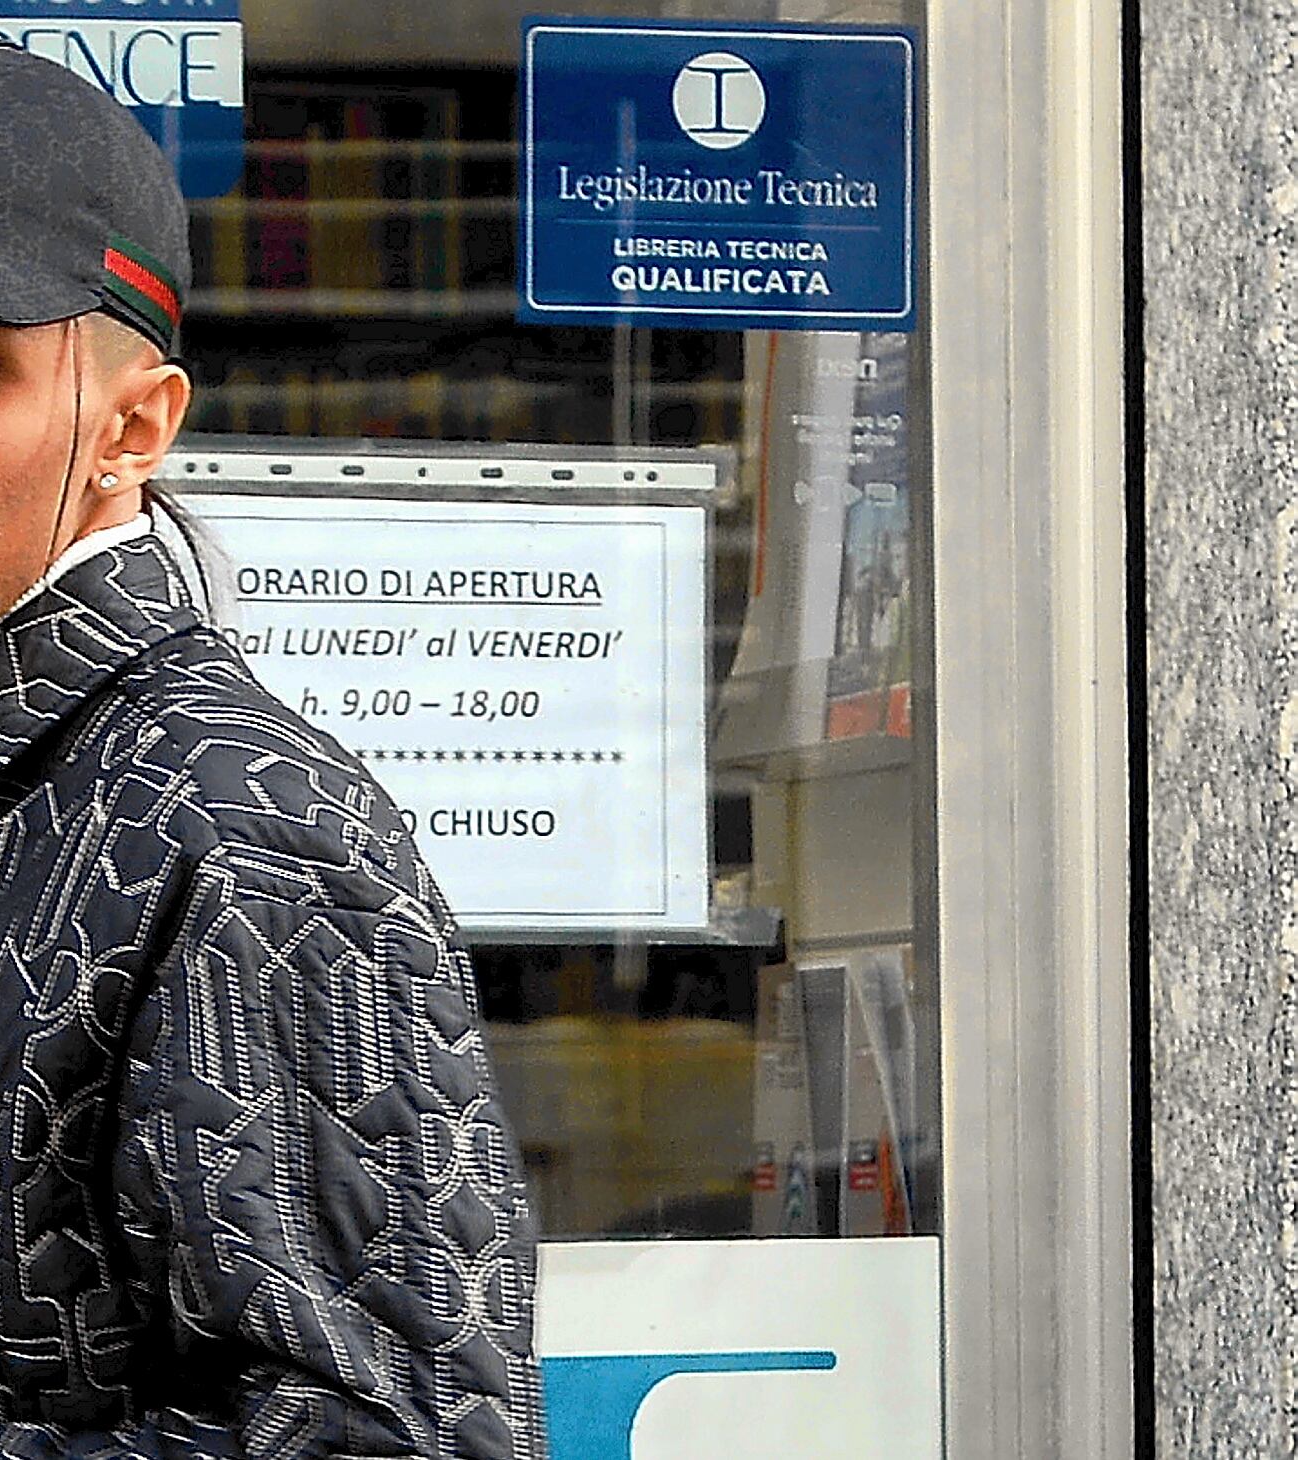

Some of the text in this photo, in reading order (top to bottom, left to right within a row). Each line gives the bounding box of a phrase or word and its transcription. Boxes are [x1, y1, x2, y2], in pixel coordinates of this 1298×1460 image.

[559, 165, 878, 210] Legislazione Tecnica
[614, 238, 828, 261] LIBRERIA TECNICA
[612, 266, 831, 295] QUALIFICATA
[237, 567, 602, 599] ORARIO DI APERTURA
[426, 628, 457, 658] al
[301, 687, 328, 716] h.
[340, 689, 412, 721] 9,00
[450, 690, 540, 722] 18,00
[429, 810, 556, 837] CHIUSO
